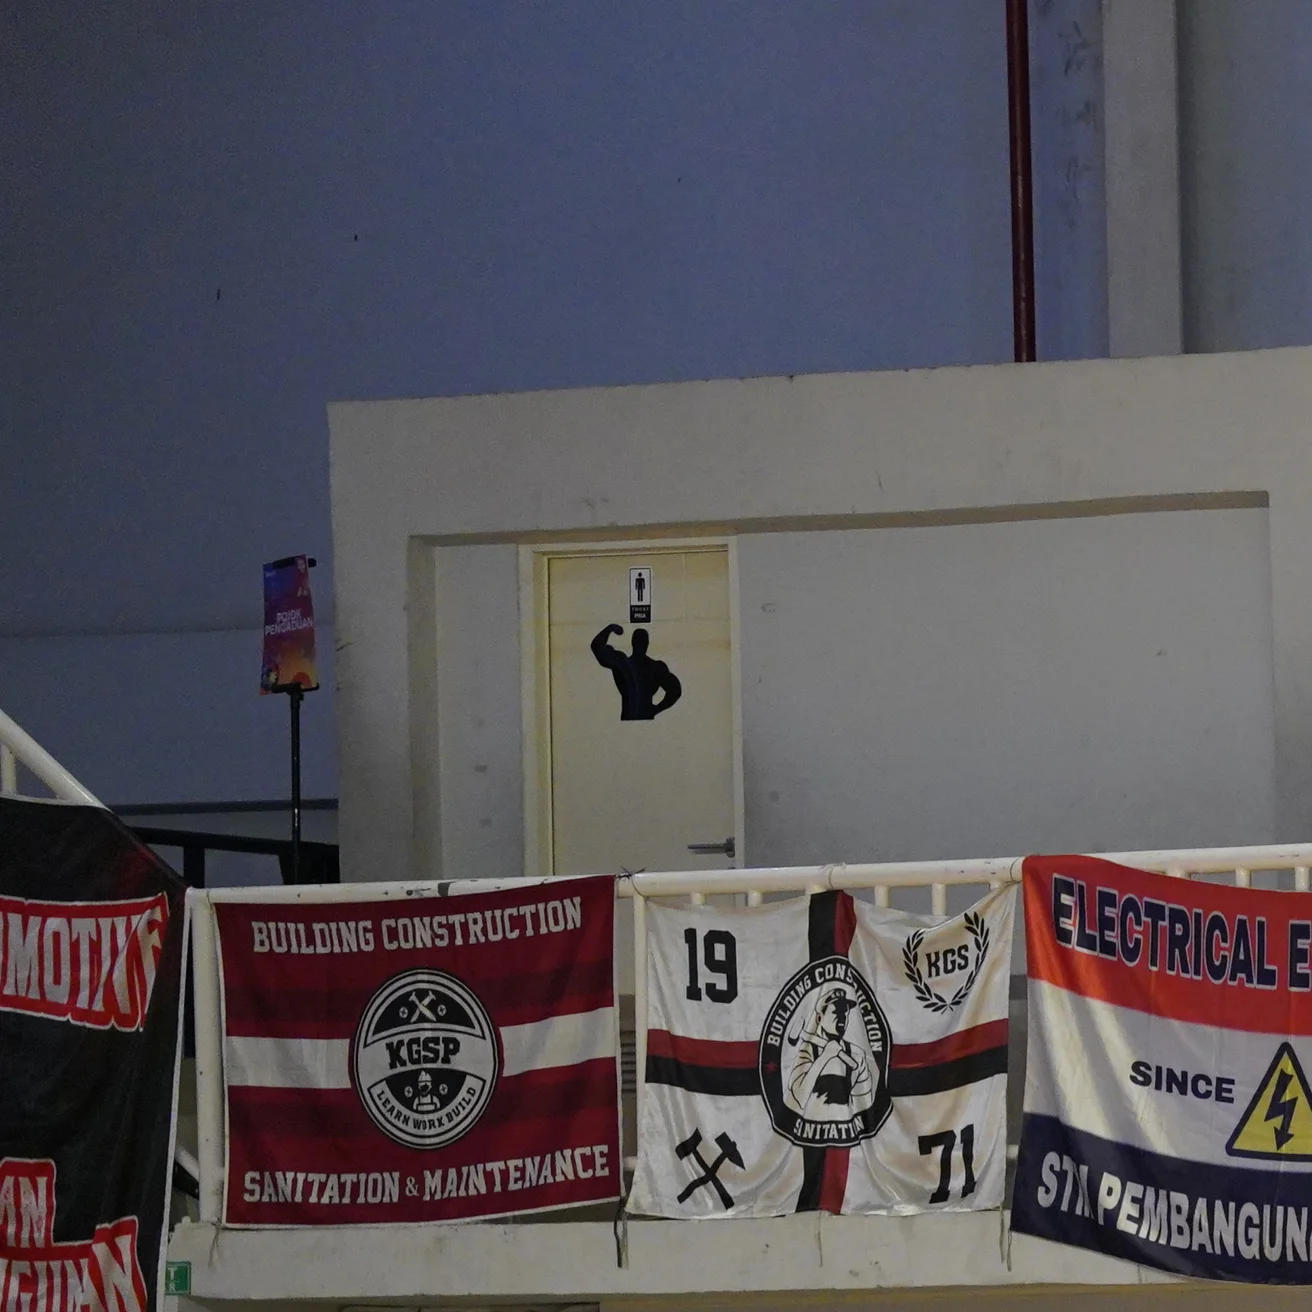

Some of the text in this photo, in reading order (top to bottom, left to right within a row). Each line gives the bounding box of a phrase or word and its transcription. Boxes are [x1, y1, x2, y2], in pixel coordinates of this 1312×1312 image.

[251, 896, 582, 954] BUILDING CONSTRUCTION
[1052, 873, 1278, 990] ELECTRICAL
[0, 905, 163, 1014] MOTIVE
[684, 927, 739, 1004] 19
[925, 943, 970, 978] KGS
[767, 974, 812, 1047] BUILDING
[385, 1036, 461, 1070] KGSP
[1129, 1060, 1236, 1104] SINCE
[377, 1086, 477, 1131] LEARN WORK BUILD
[794, 1115, 866, 1140] SNITATIN
[243, 1144, 610, 1204] SANITATION & MAINTENANCE
[918, 1123, 977, 1204] 71
